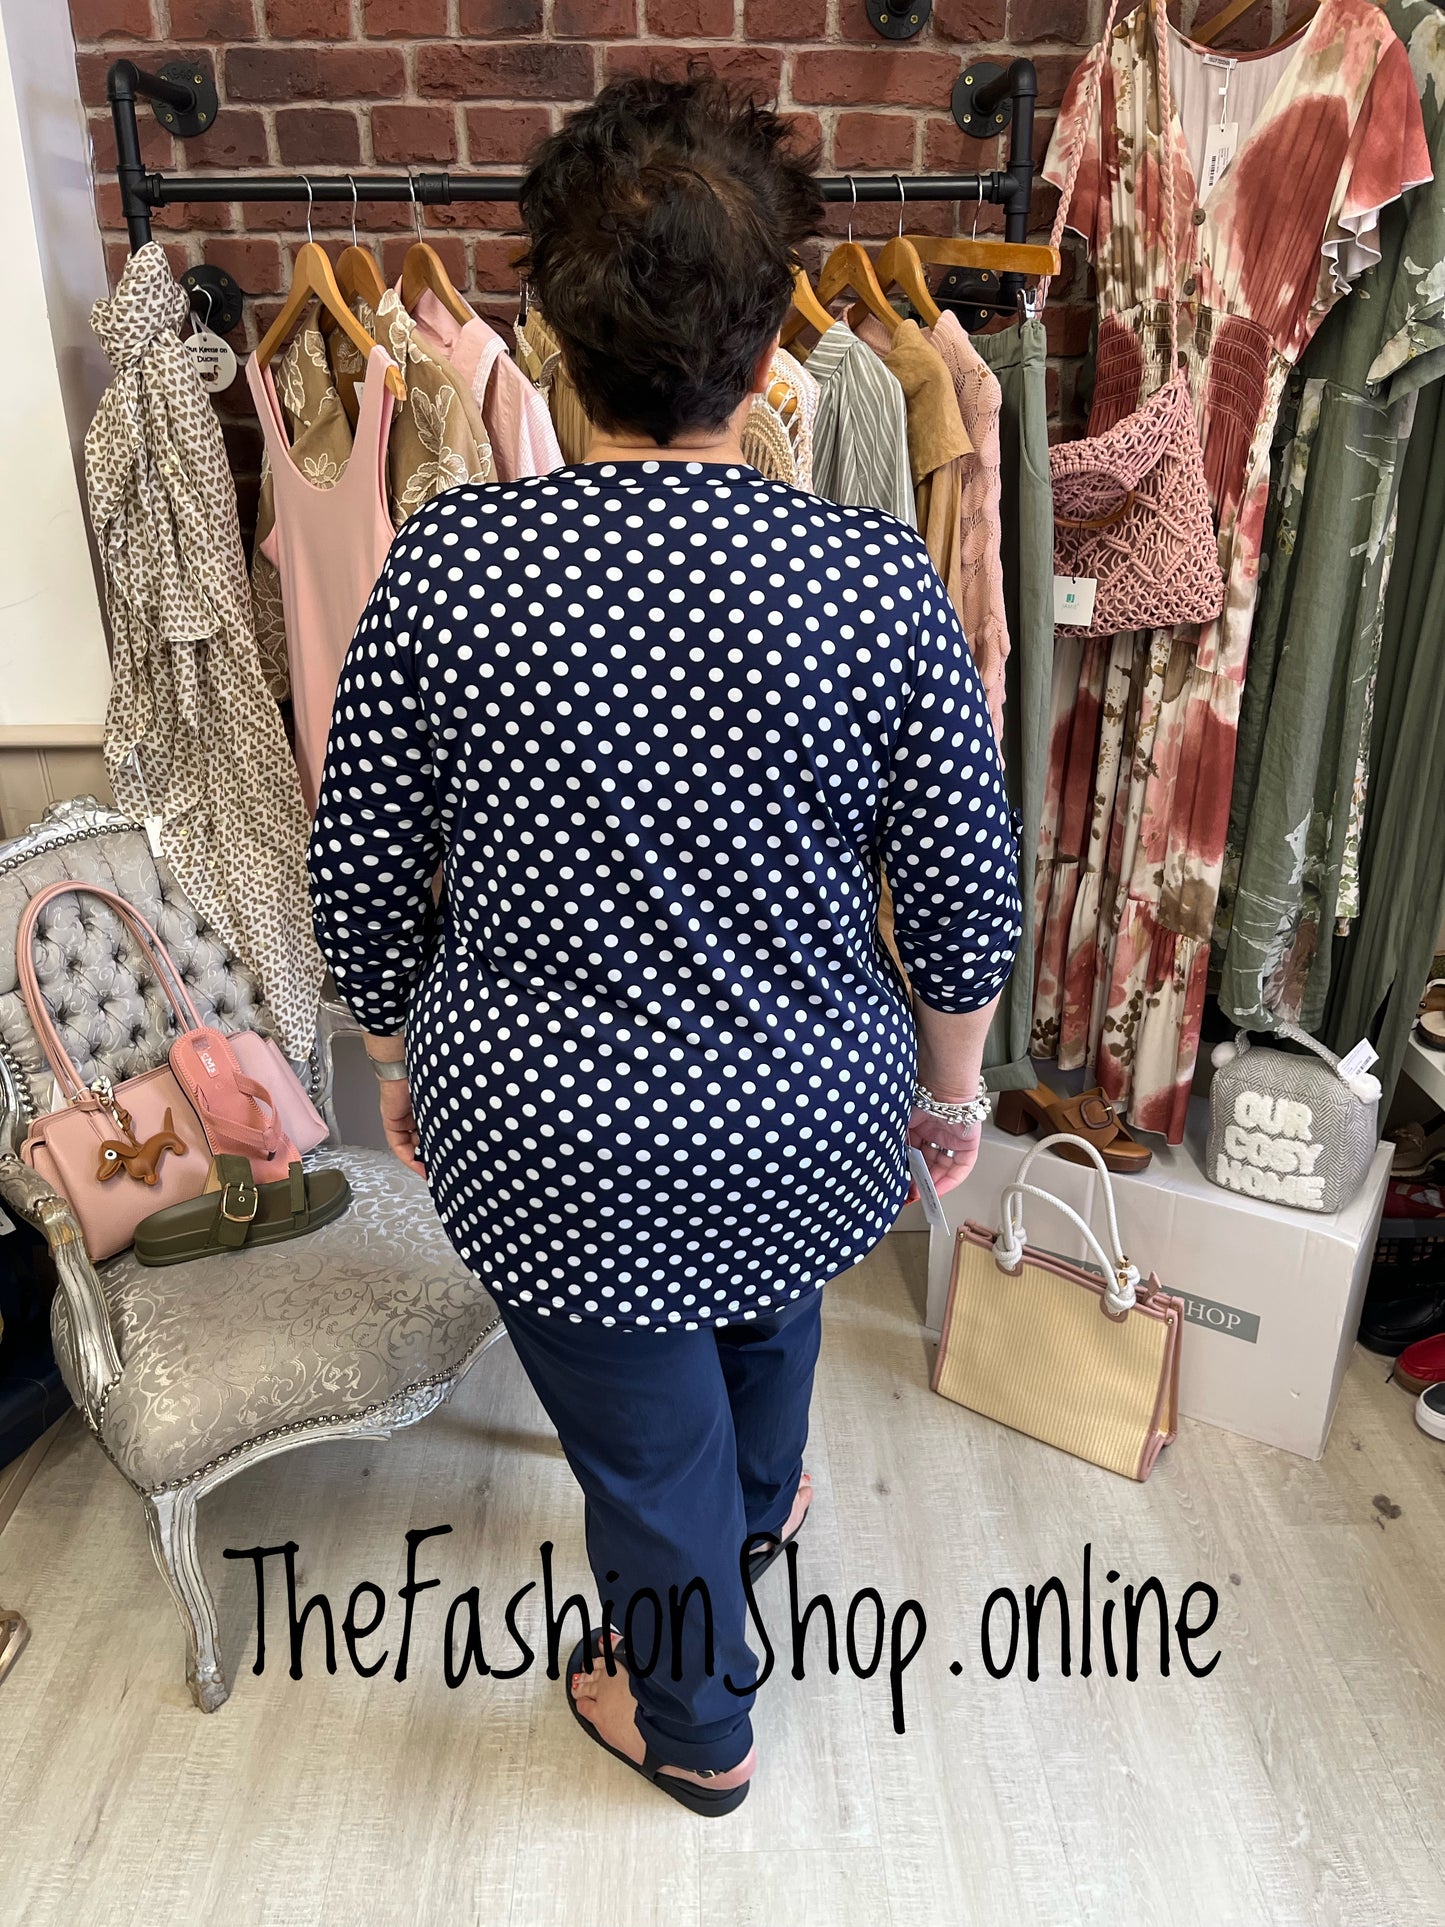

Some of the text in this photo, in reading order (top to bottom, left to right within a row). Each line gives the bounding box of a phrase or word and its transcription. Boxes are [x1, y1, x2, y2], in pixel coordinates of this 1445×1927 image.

[1234, 1091, 1313, 1141] OUR
[1225, 1125, 1324, 1176] COSY
[1216, 1153, 1326, 1209] HOME
[1185, 1300, 1242, 1331] HOP
